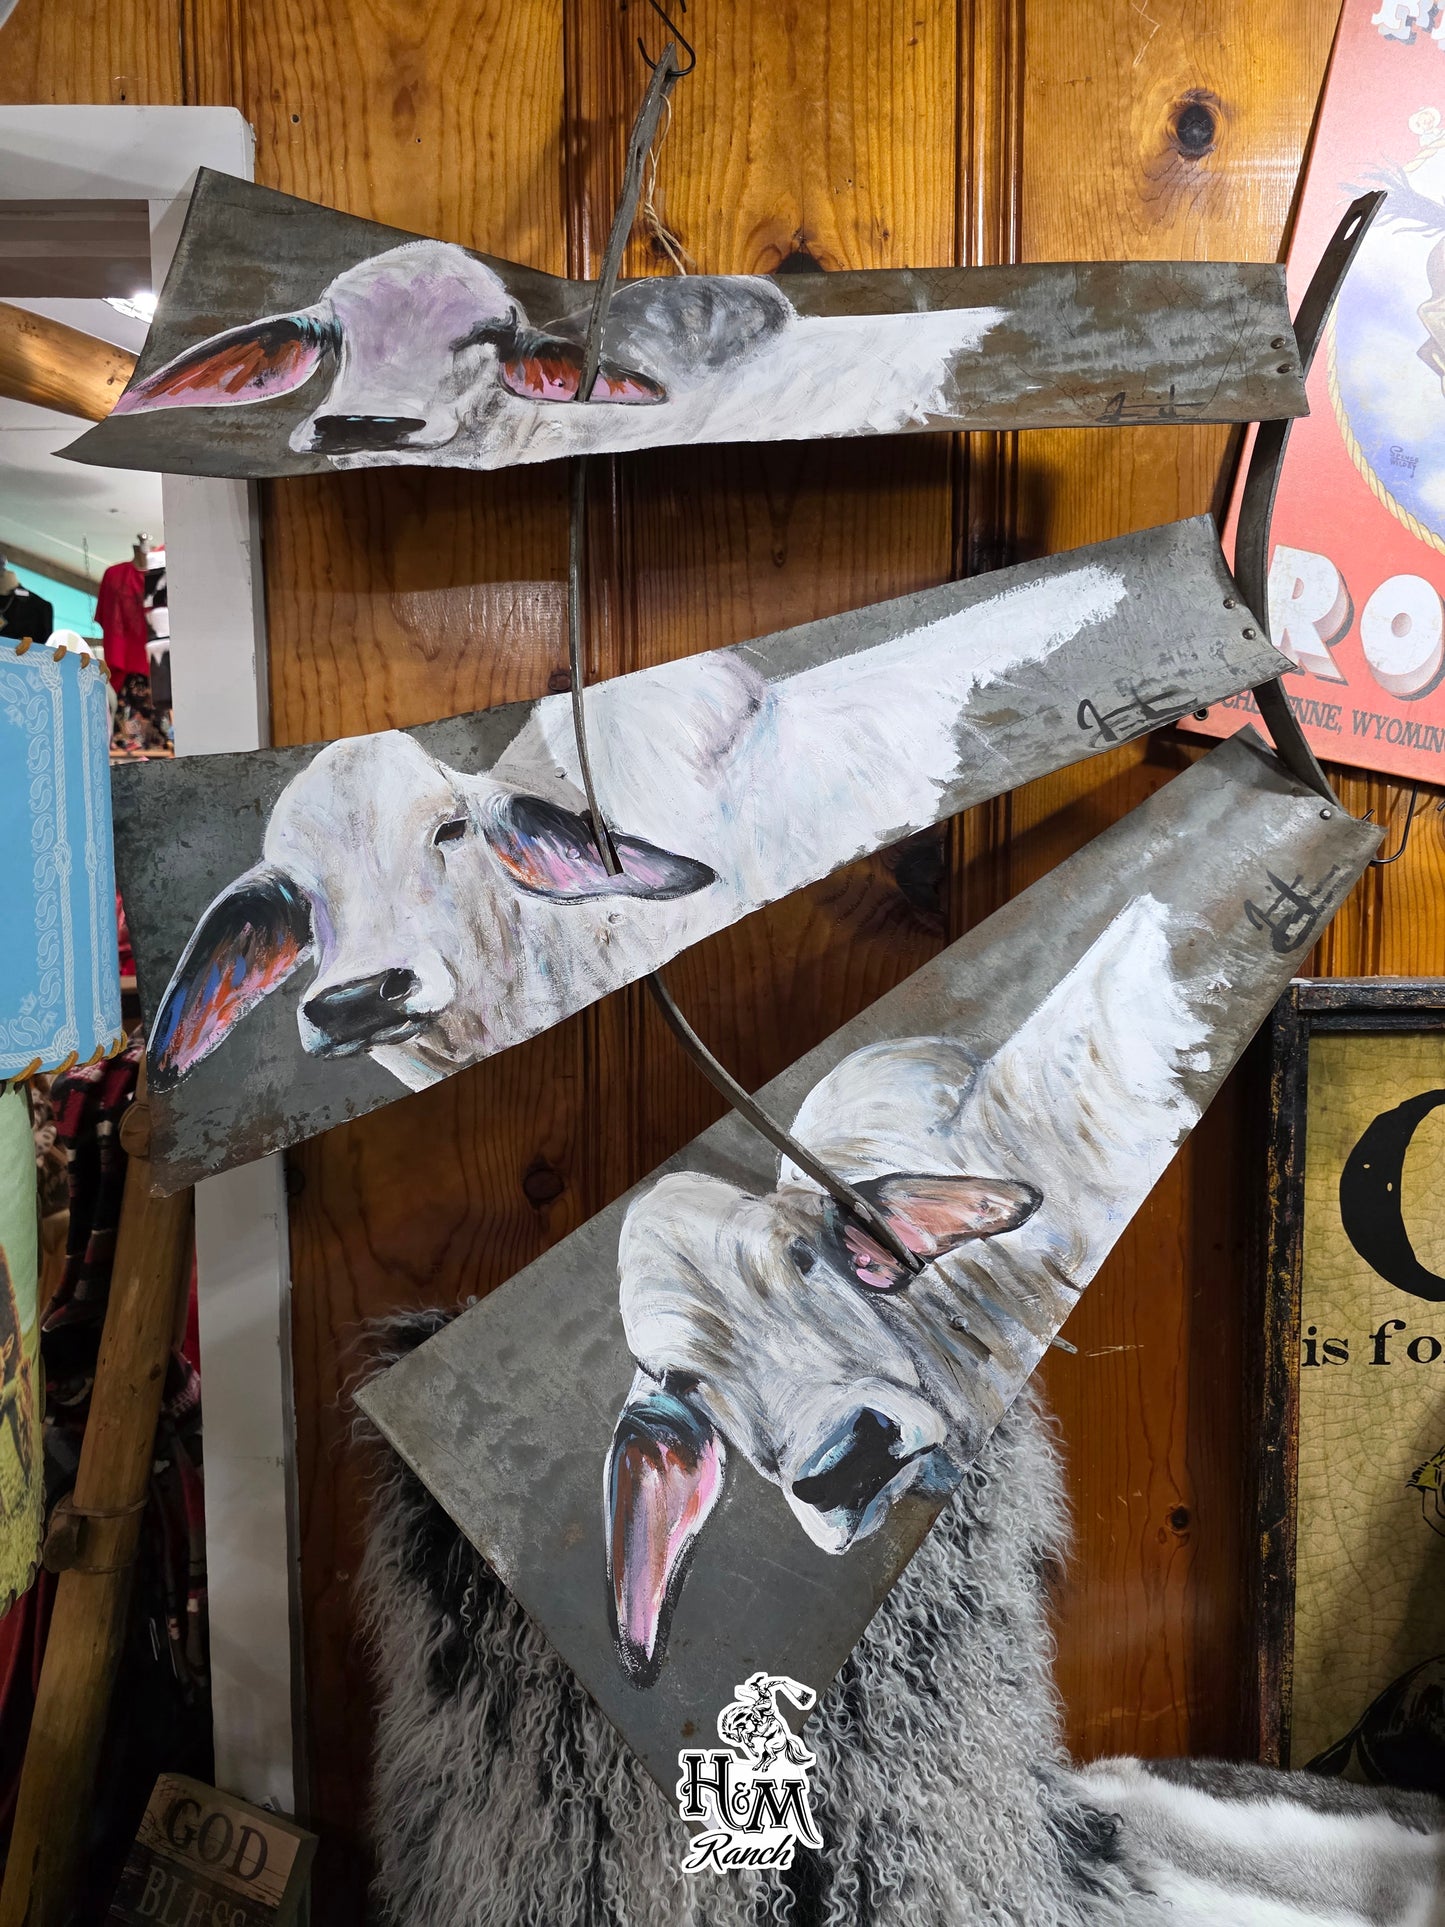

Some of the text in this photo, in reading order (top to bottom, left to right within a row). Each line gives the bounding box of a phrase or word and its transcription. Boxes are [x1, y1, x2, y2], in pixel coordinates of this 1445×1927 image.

[1352, 709, 1445, 753] WYOMIN
[1301, 1319, 1445, 1367] is fo
[164, 1797, 268, 1881] GOD
